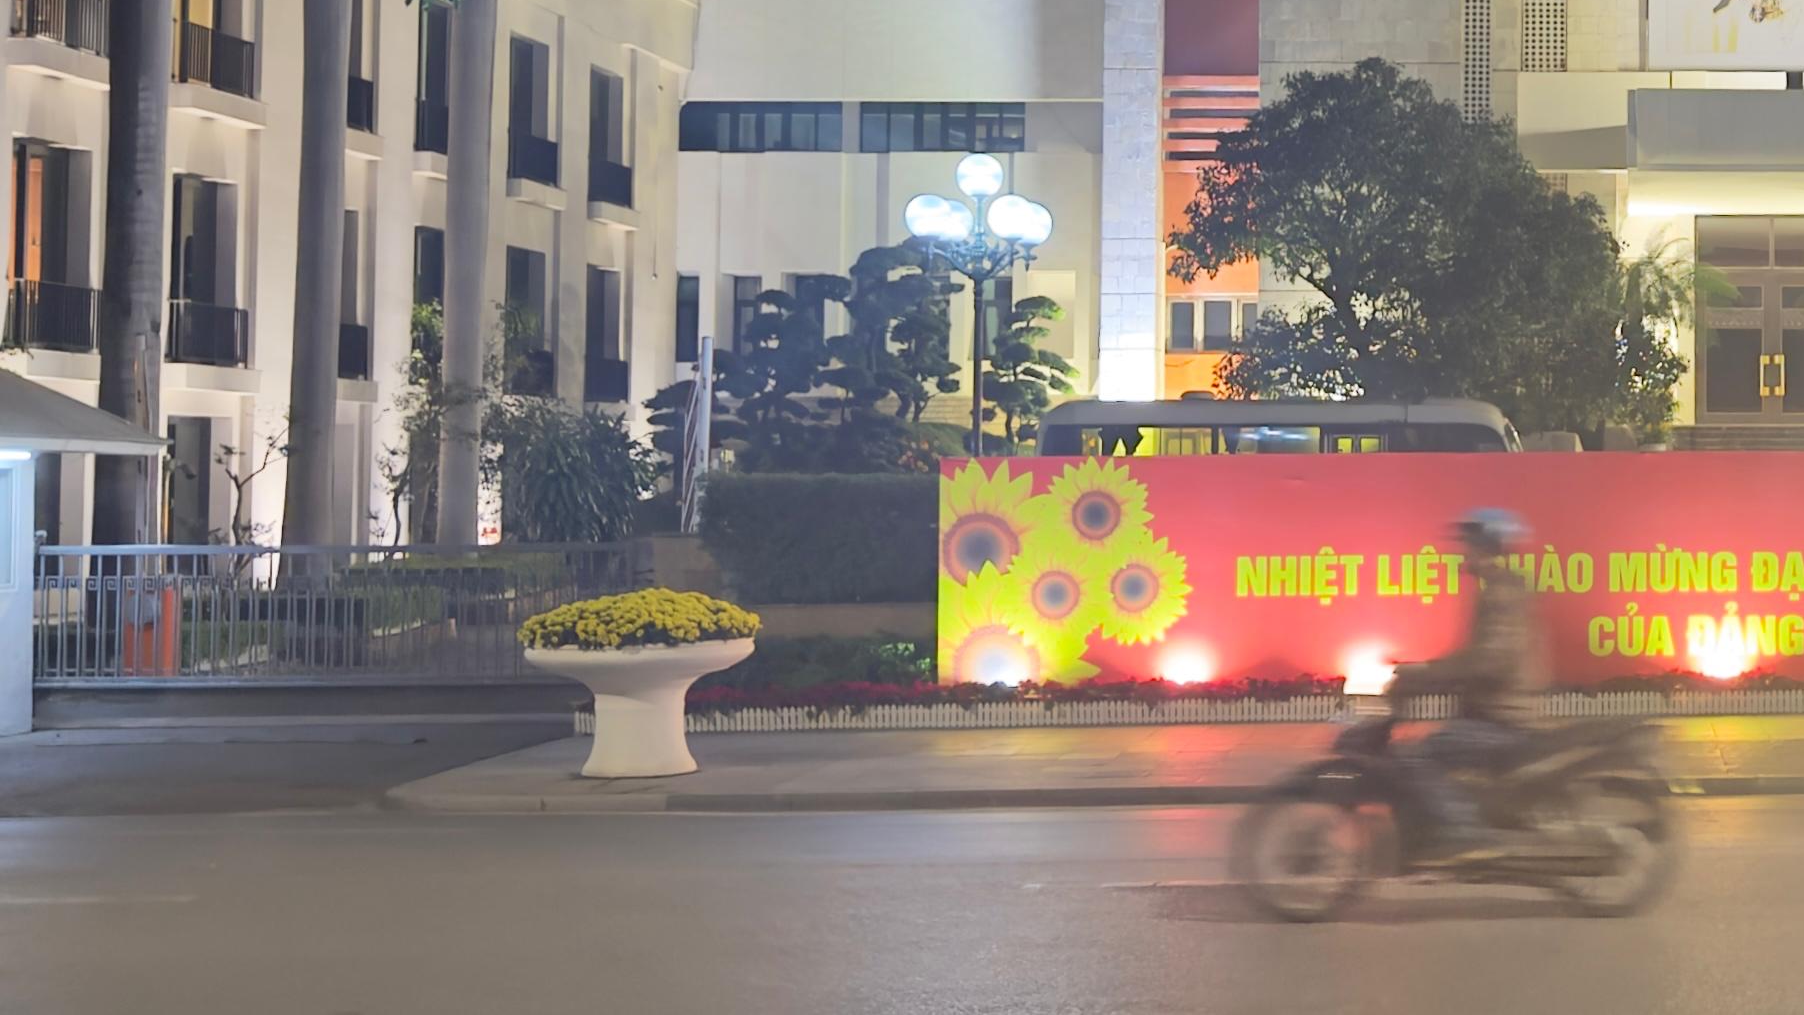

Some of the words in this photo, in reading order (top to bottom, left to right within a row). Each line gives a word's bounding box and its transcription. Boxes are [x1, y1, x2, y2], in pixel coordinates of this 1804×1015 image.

[1236, 546, 1364, 606] NHIỆT
[1376, 545, 1464, 604] LIỆT
[1479, 544, 1594, 594] HÀO
[1608, 543, 1738, 594] MỪNG
[1588, 602, 1676, 657] CỦA
